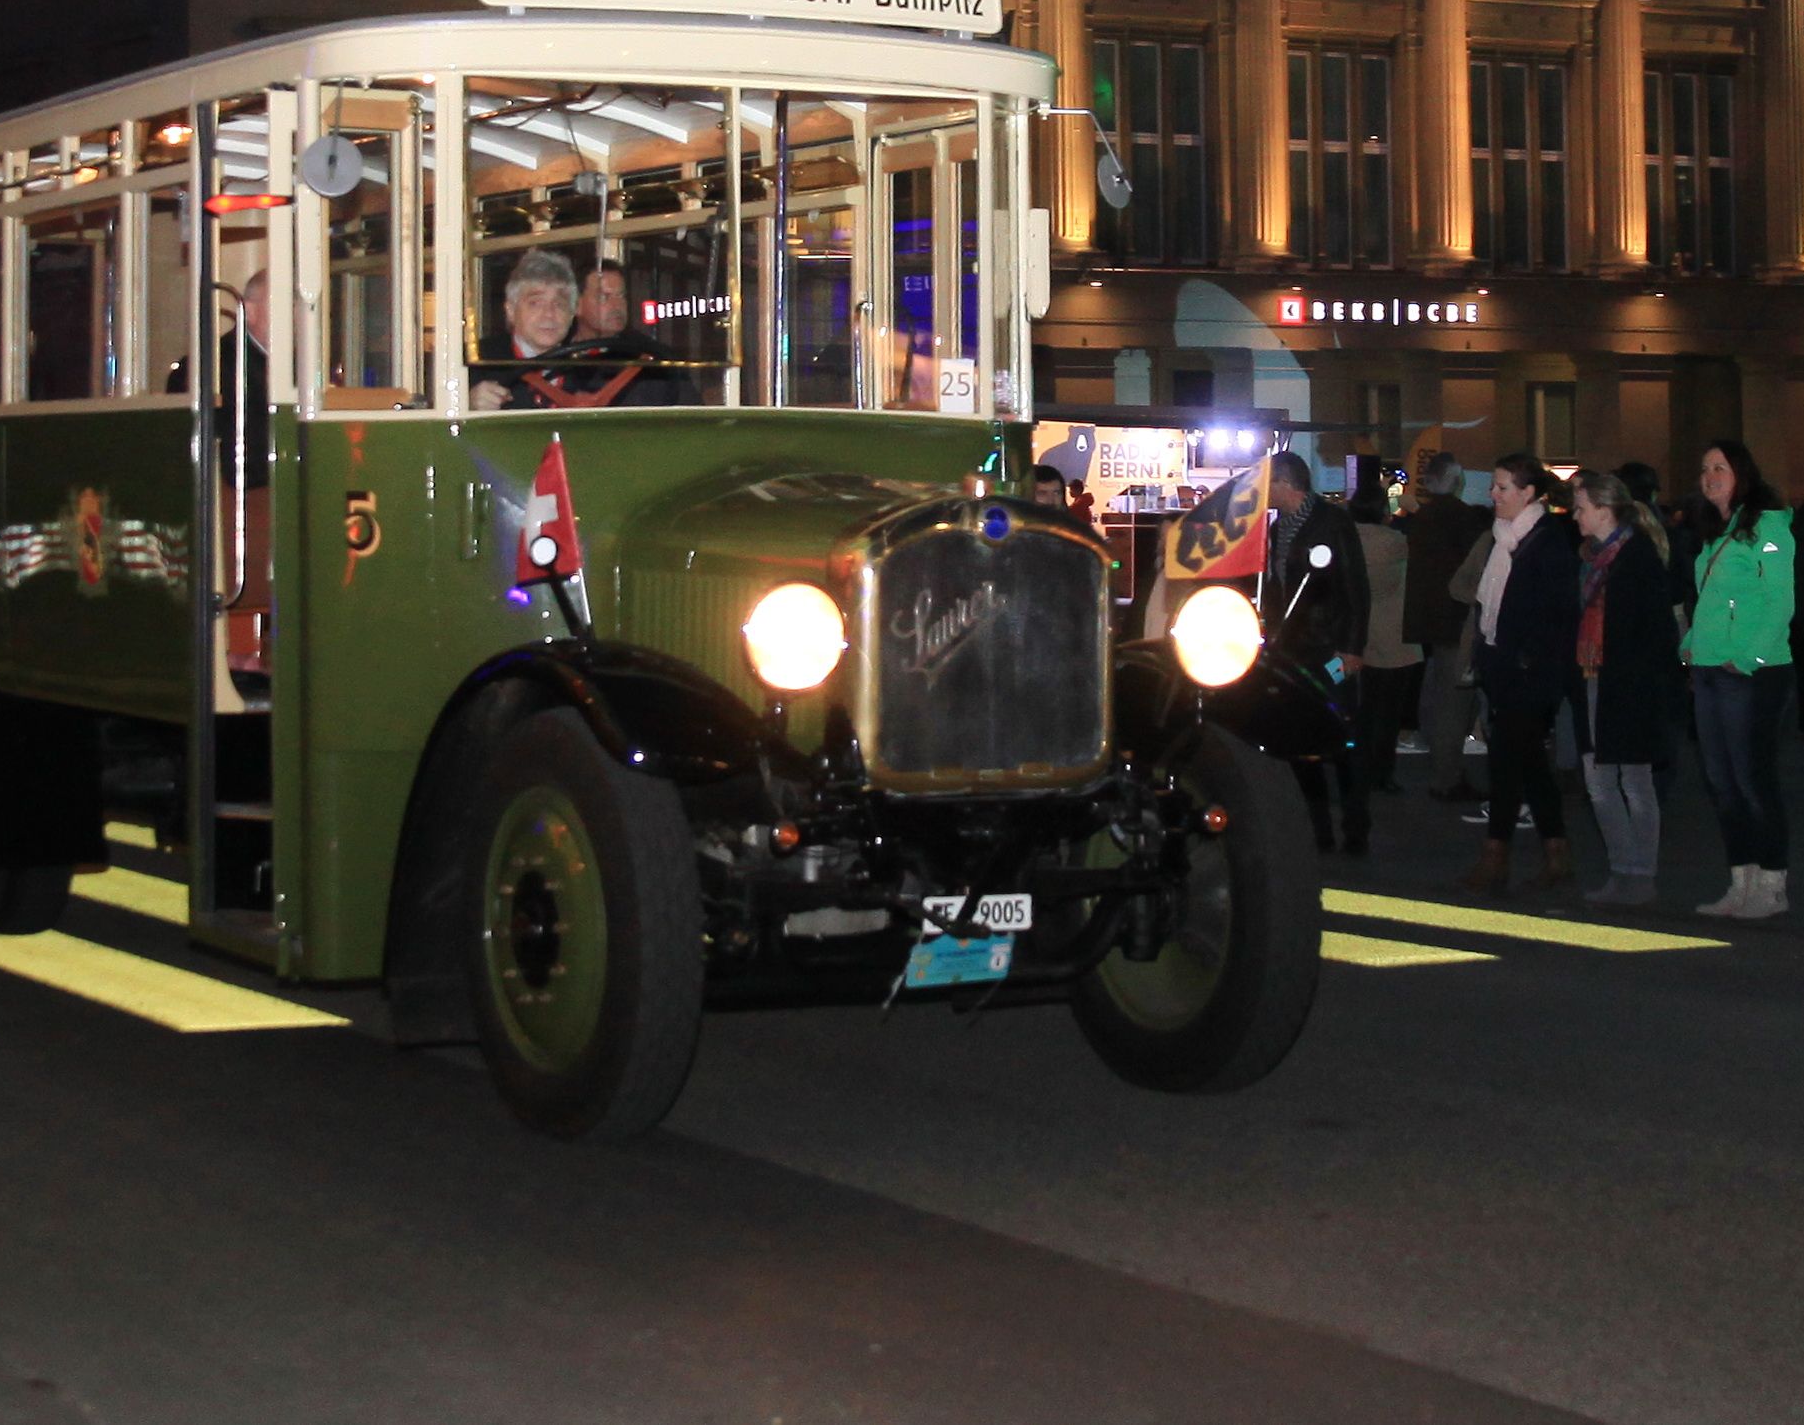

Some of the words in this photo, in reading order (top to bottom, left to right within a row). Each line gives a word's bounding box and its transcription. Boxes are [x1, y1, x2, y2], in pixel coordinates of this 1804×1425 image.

[1311, 300, 1386, 322] BEKB
[1407, 302, 1479, 323] BCBE
[941, 372, 971, 396] 25
[1099, 443, 1161, 460] RADIO
[345, 491, 381, 557] 5
[980, 901, 1025, 923] 9005
